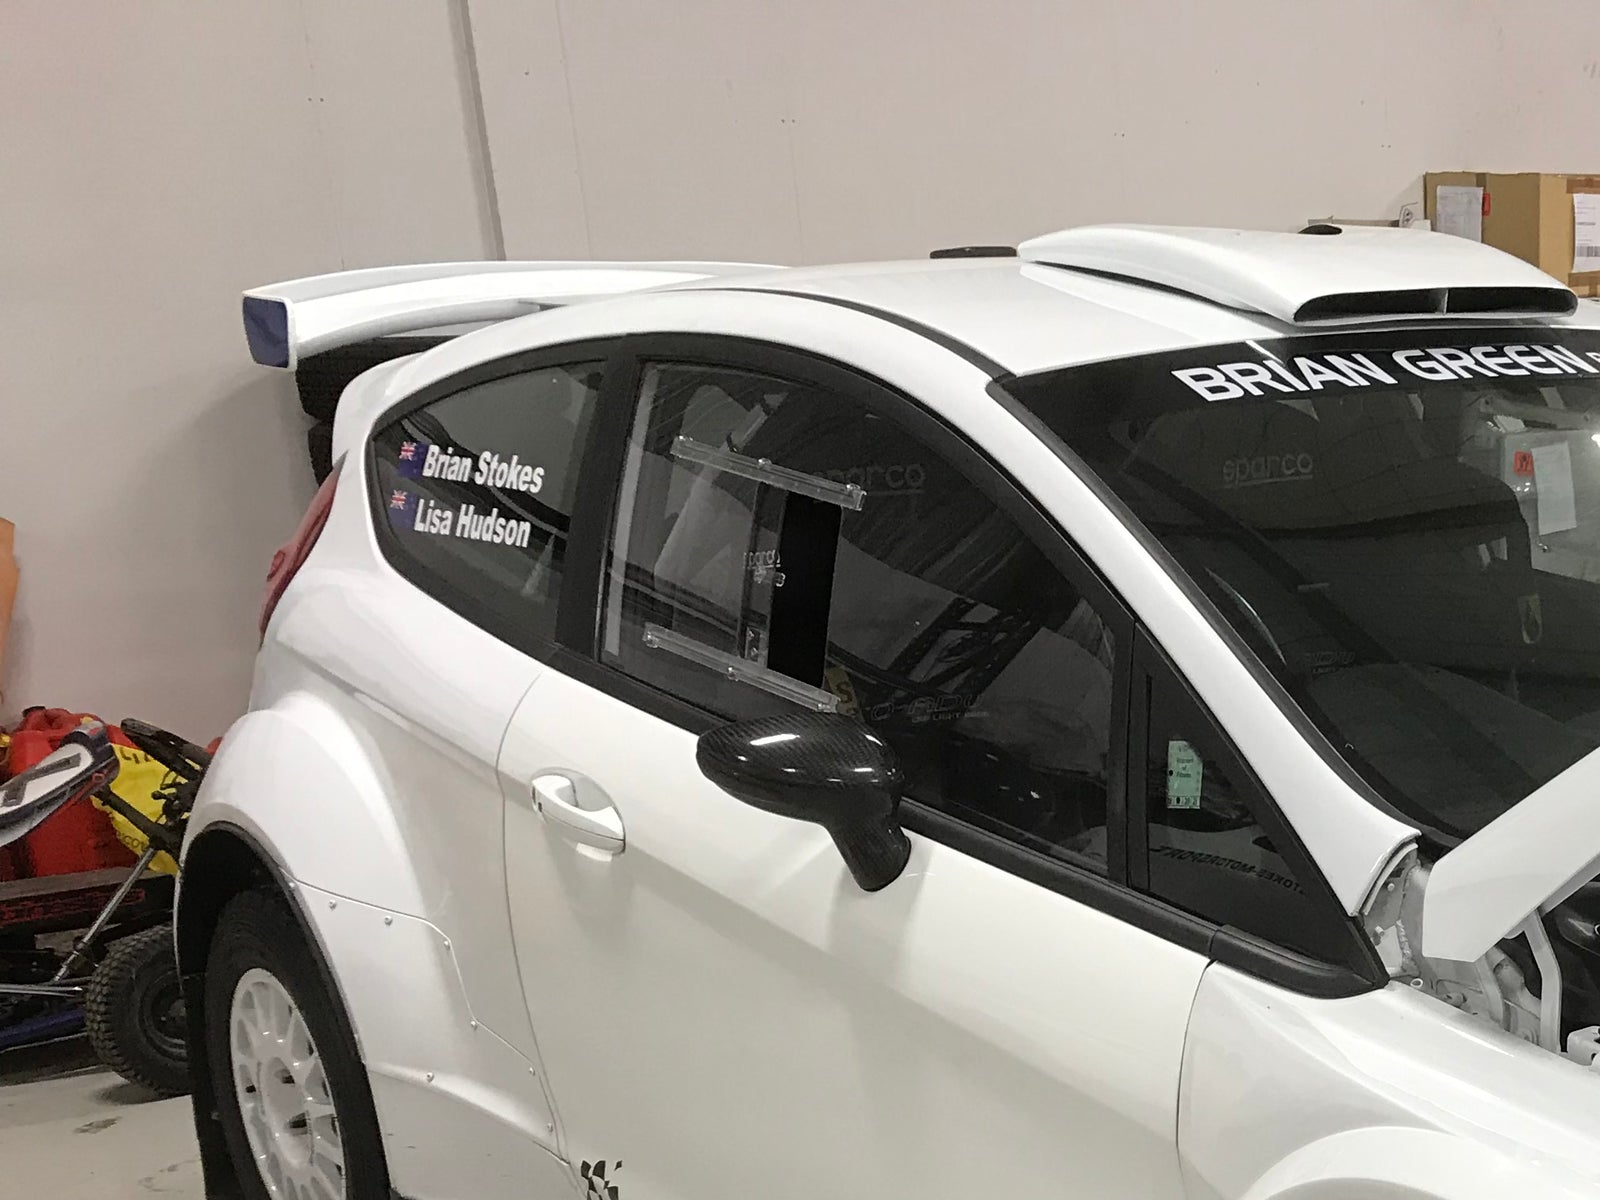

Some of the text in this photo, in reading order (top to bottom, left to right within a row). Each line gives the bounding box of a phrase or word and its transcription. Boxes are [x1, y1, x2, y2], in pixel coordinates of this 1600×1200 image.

[1171, 353, 1399, 402] BRIAN
[1391, 344, 1600, 380] GREEN
[422, 444, 545, 494] Brian Stokes
[414, 498, 532, 548] Lisa Hudson
